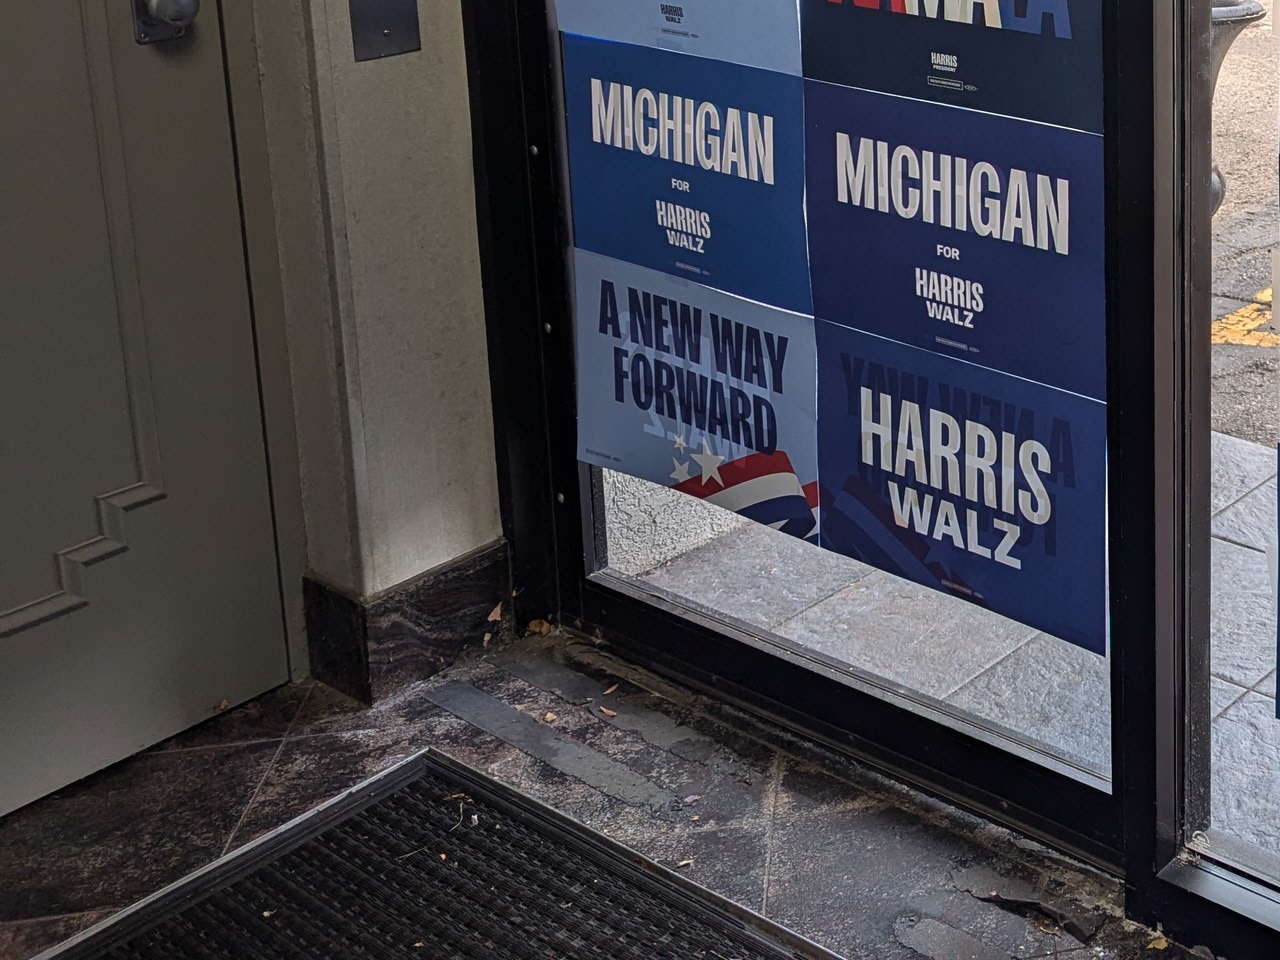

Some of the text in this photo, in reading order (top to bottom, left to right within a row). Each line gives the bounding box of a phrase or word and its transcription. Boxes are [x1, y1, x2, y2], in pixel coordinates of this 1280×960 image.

[660, 3, 684, 18] HARRIS
[931, 51, 958, 68] HARRIS
[590, 77, 775, 186] MICHIGAN
[671, 177, 691, 193] FOR
[835, 131, 1070, 257] MICHIGAN
[655, 198, 711, 240] HARRIS
[666, 228, 705, 255] WALZ
[936, 243, 961, 262] FOR
[914, 266, 984, 313] HARRIS
[598, 278, 789, 395] A NEW WAY
[925, 300, 974, 330] WALZ
[612, 345, 779, 456] FORWARD
[859, 385, 1053, 526] HARRIS
[887, 480, 1022, 571] WALZ
